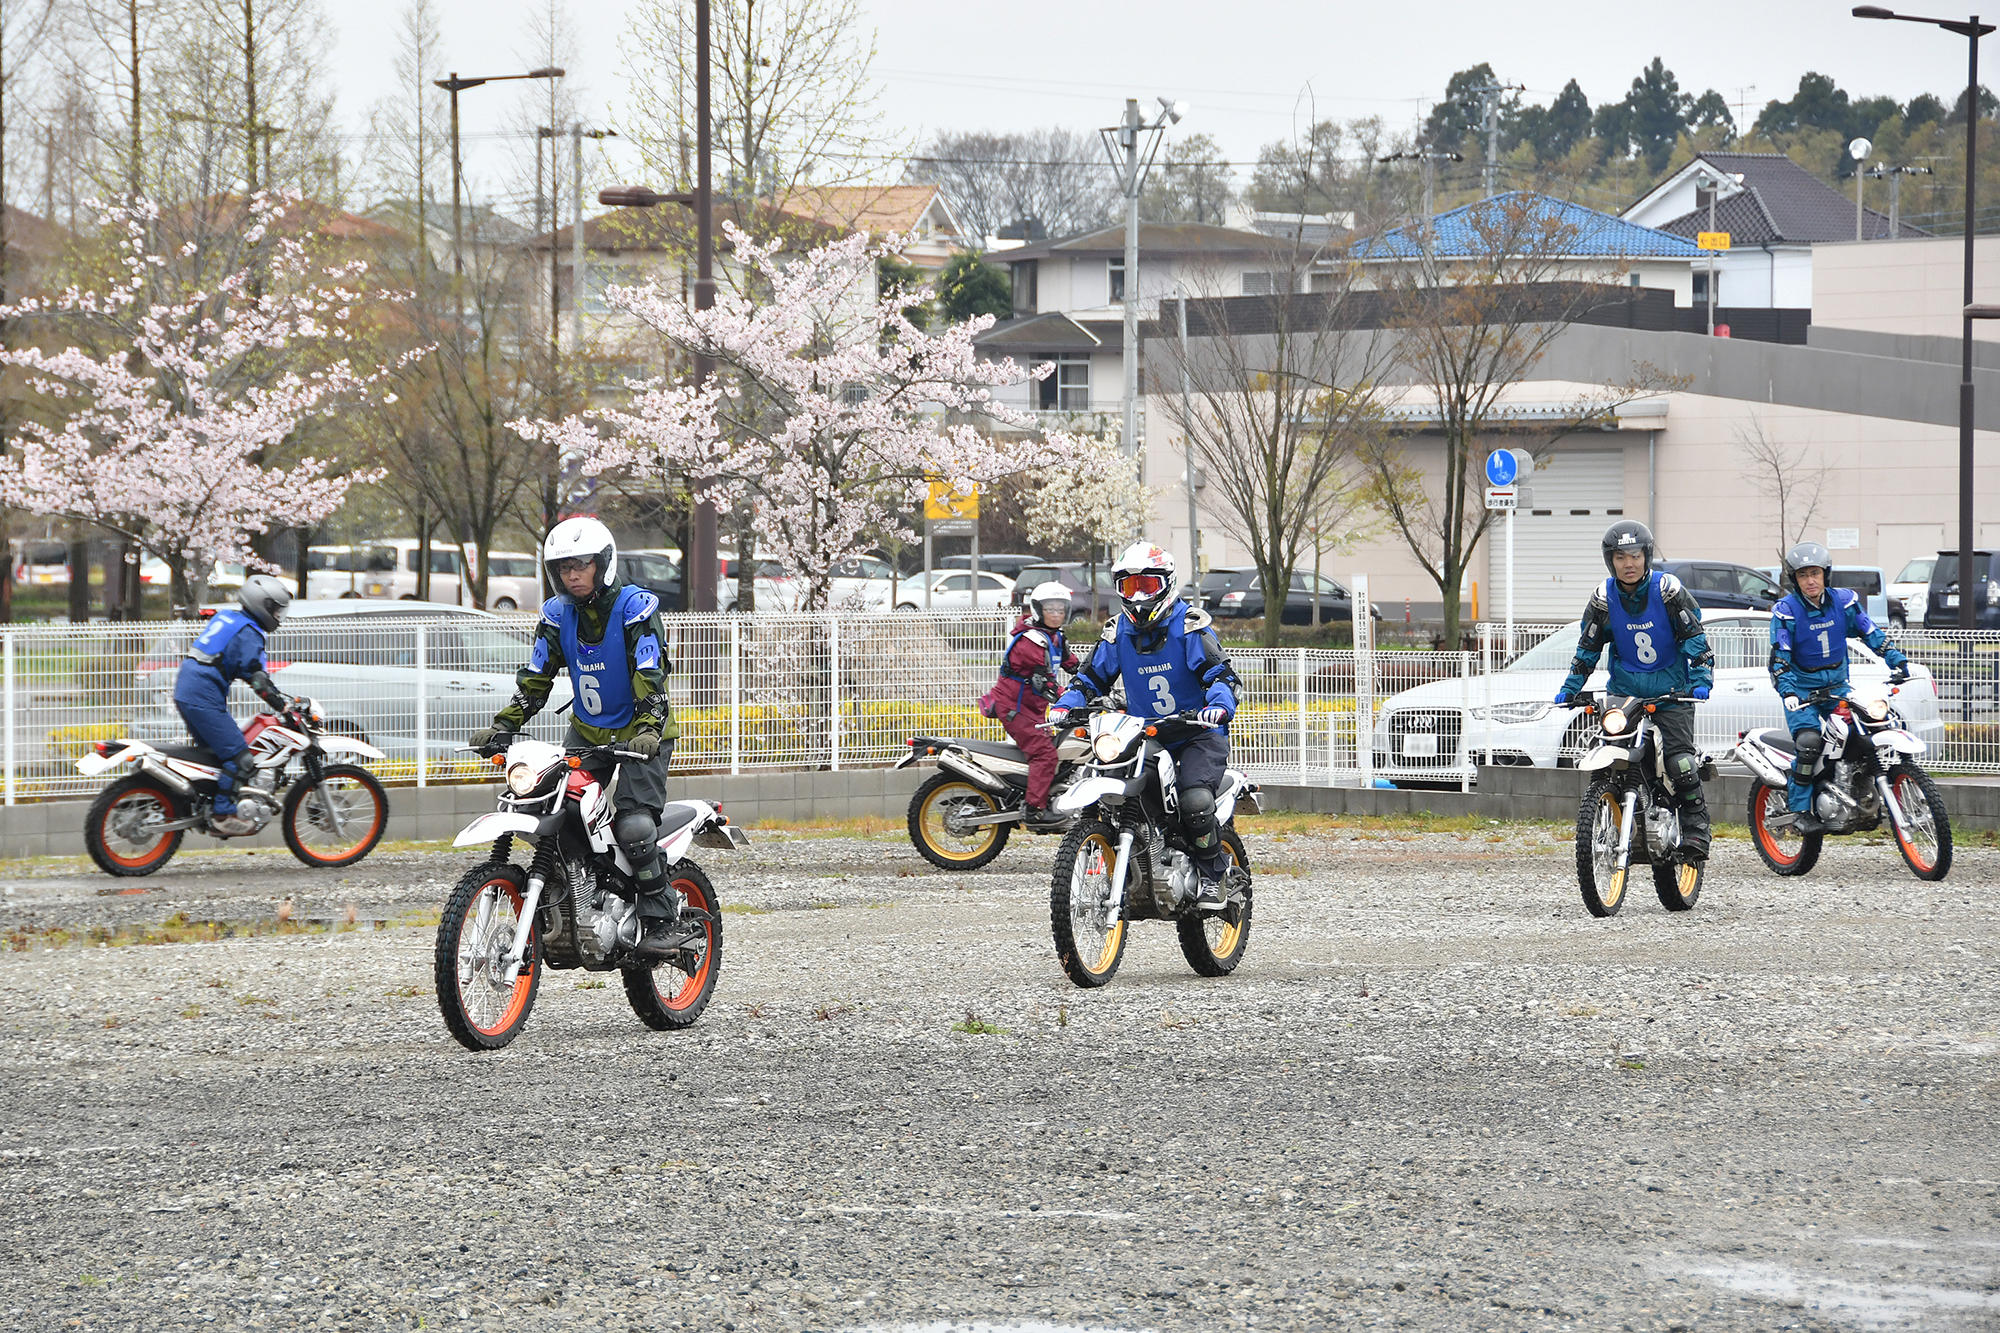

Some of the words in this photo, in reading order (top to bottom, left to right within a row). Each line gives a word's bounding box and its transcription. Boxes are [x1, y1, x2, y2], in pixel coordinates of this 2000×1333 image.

[1487, 499, 1515, 507] 歩行者優先
[199, 620, 223, 645] 2
[1816, 630, 1830, 658] 1
[1634, 631, 1657, 664] 8
[1143, 662, 1173, 674] YAMAHA
[579, 674, 602, 716] 6
[1148, 675, 1176, 716] 3
